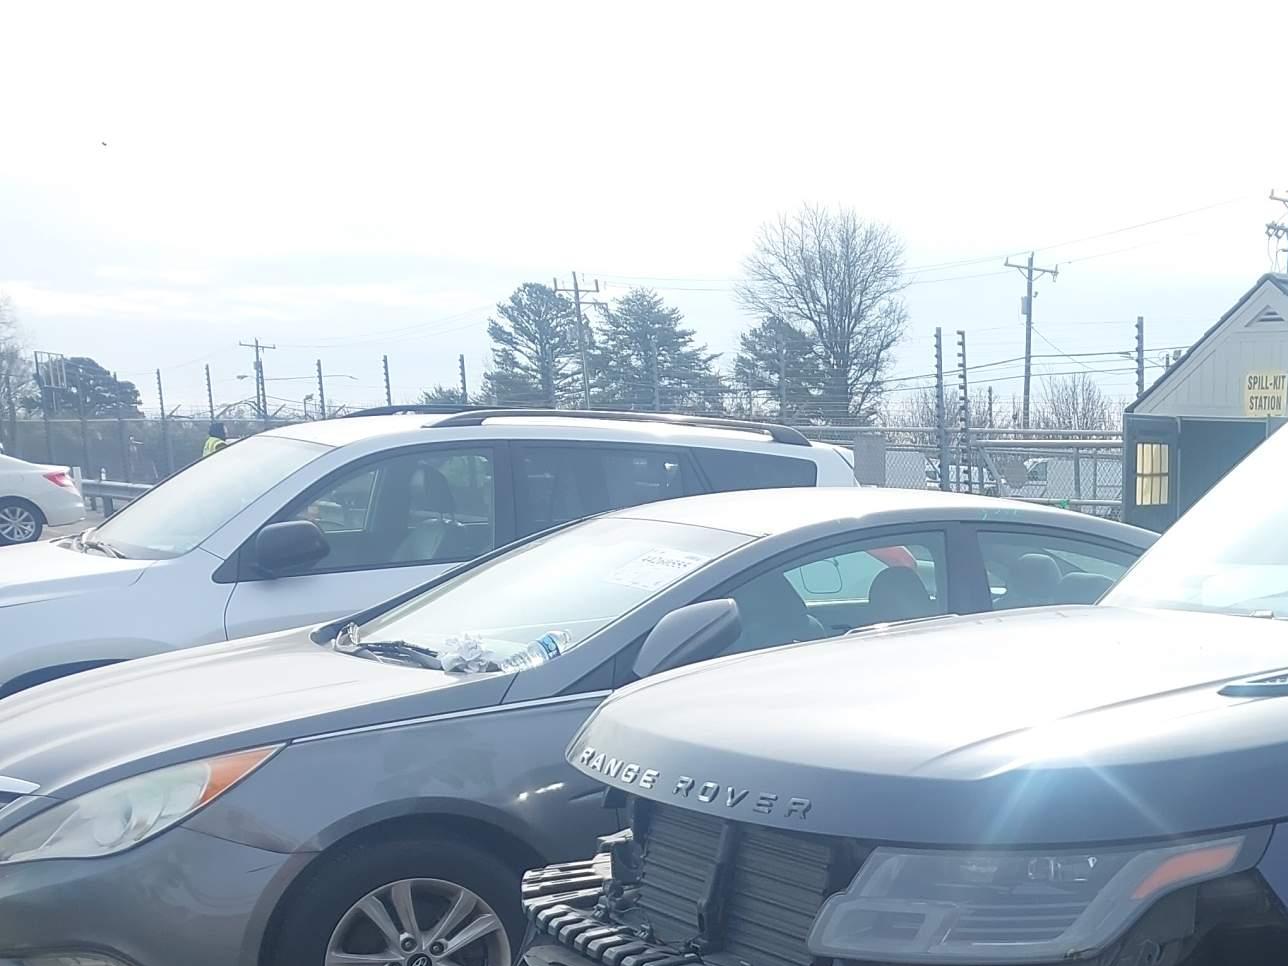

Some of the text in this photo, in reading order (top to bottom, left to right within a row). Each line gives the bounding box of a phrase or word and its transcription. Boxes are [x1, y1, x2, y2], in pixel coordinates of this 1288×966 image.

[1247, 375, 1286, 390] SPILL-KIT
[1249, 395, 1282, 410] STATION
[578, 747, 812, 820] RANGE ROVER
